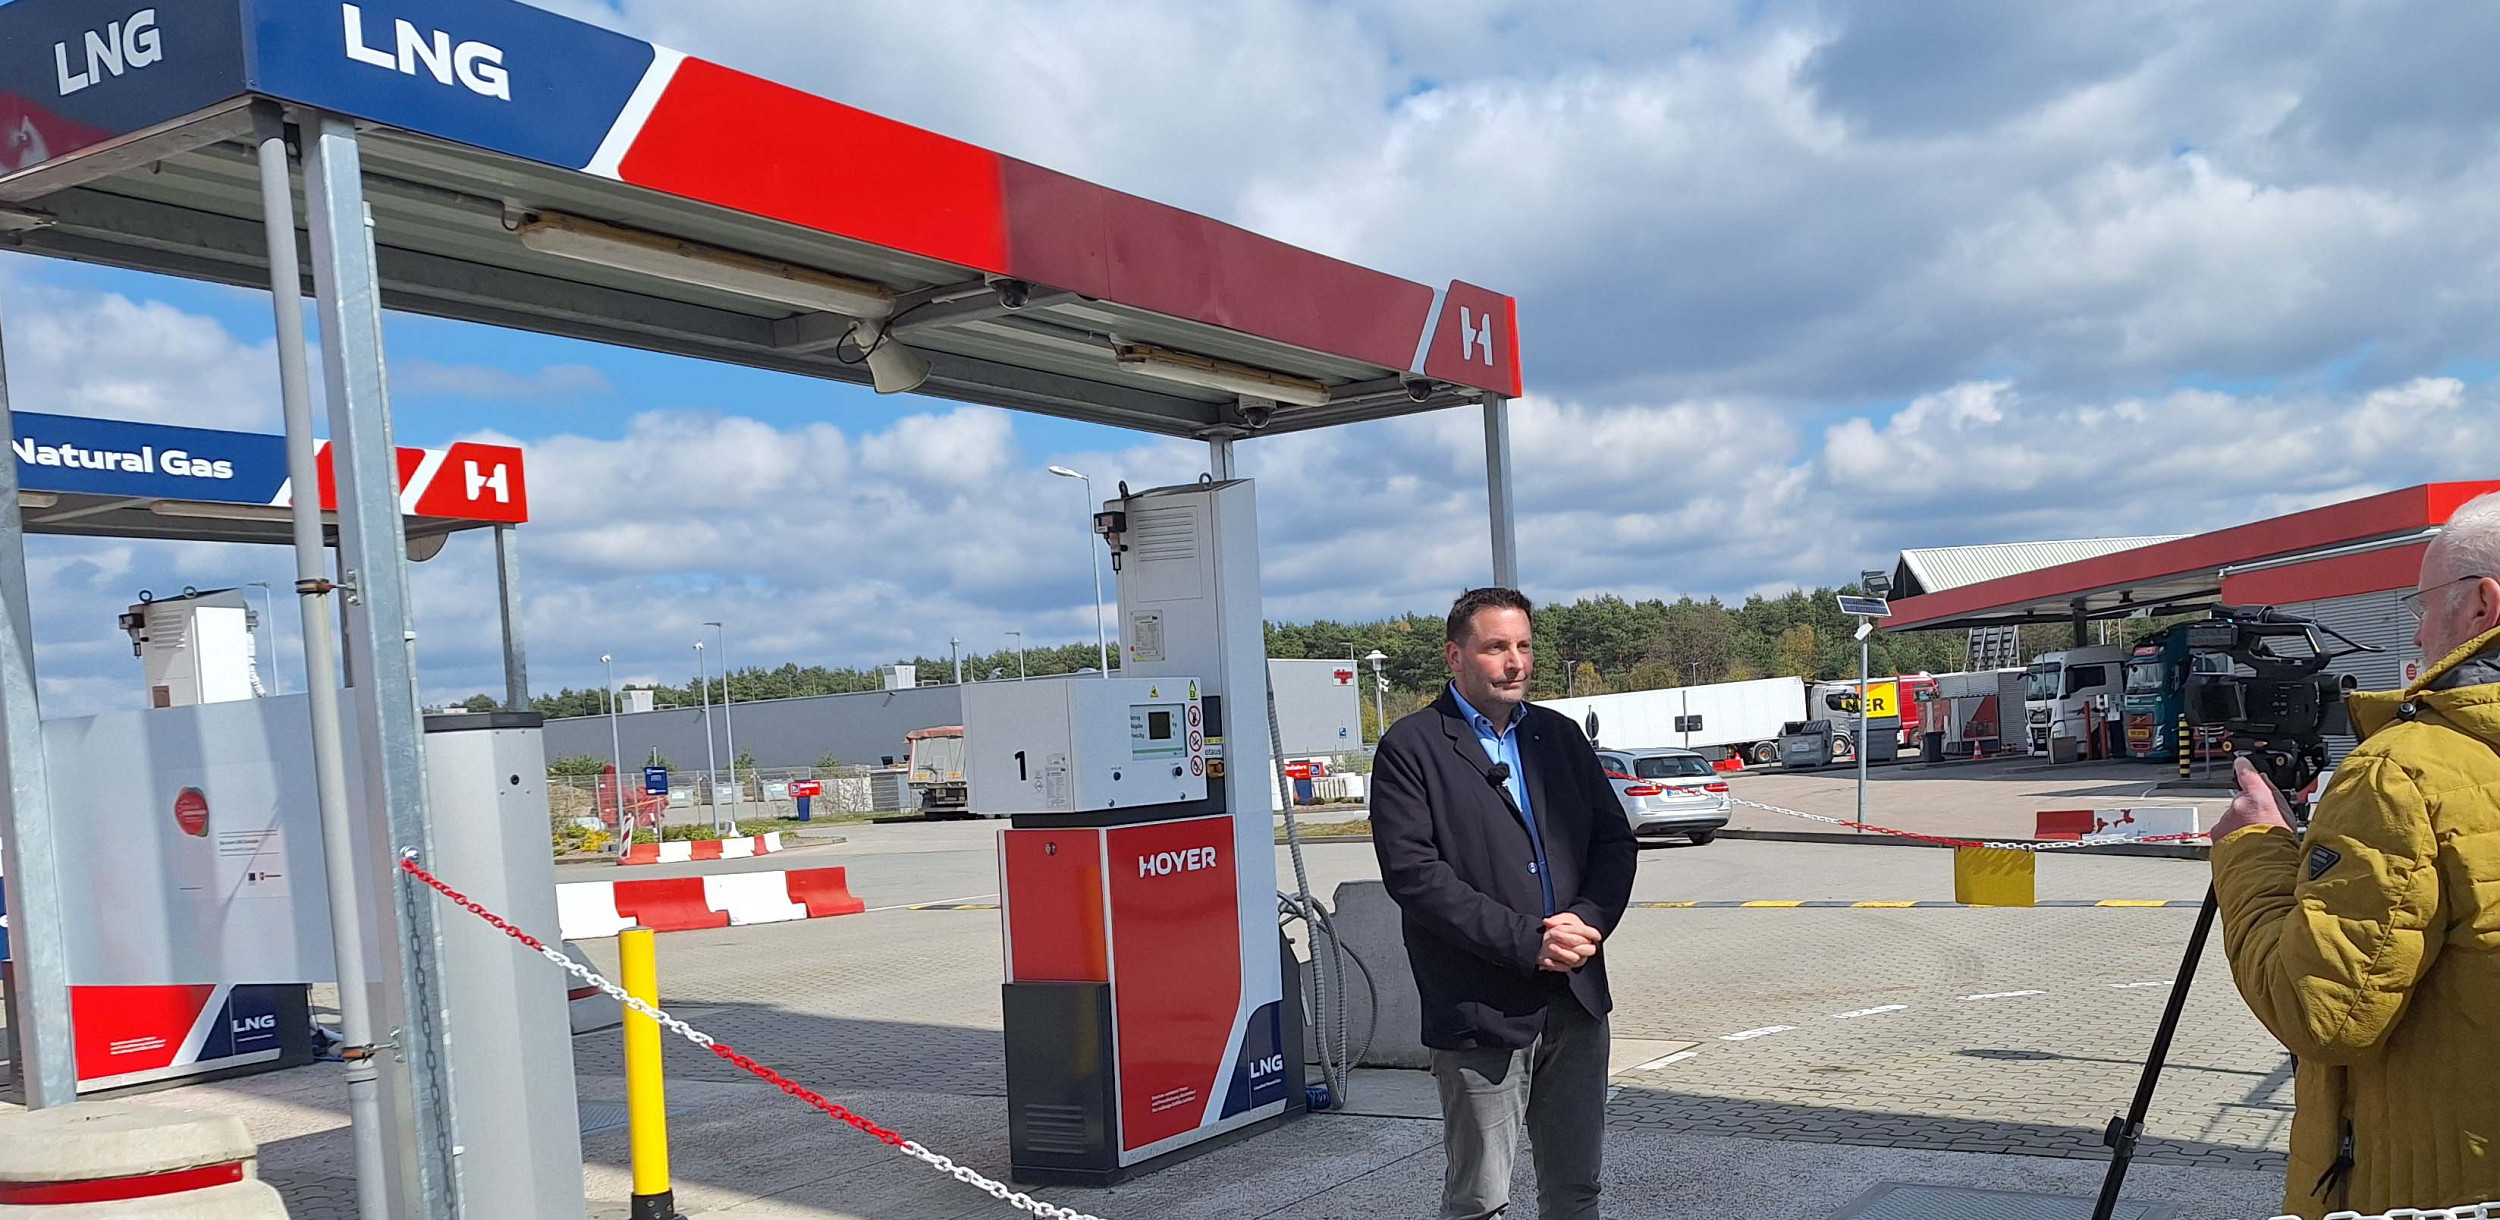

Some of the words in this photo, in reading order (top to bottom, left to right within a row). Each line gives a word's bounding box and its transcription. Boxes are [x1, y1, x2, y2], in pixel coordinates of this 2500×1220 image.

[54, 9, 162, 96] LNG
[342, 3, 511, 101] LNG
[12, 437, 154, 473] Natural
[160, 450, 234, 479] Gas
[1014, 750, 1026, 781] 1
[1138, 846, 1216, 878] HOYER
[232, 1014, 276, 1033] LNG
[1250, 1054, 1283, 1079] LNG
